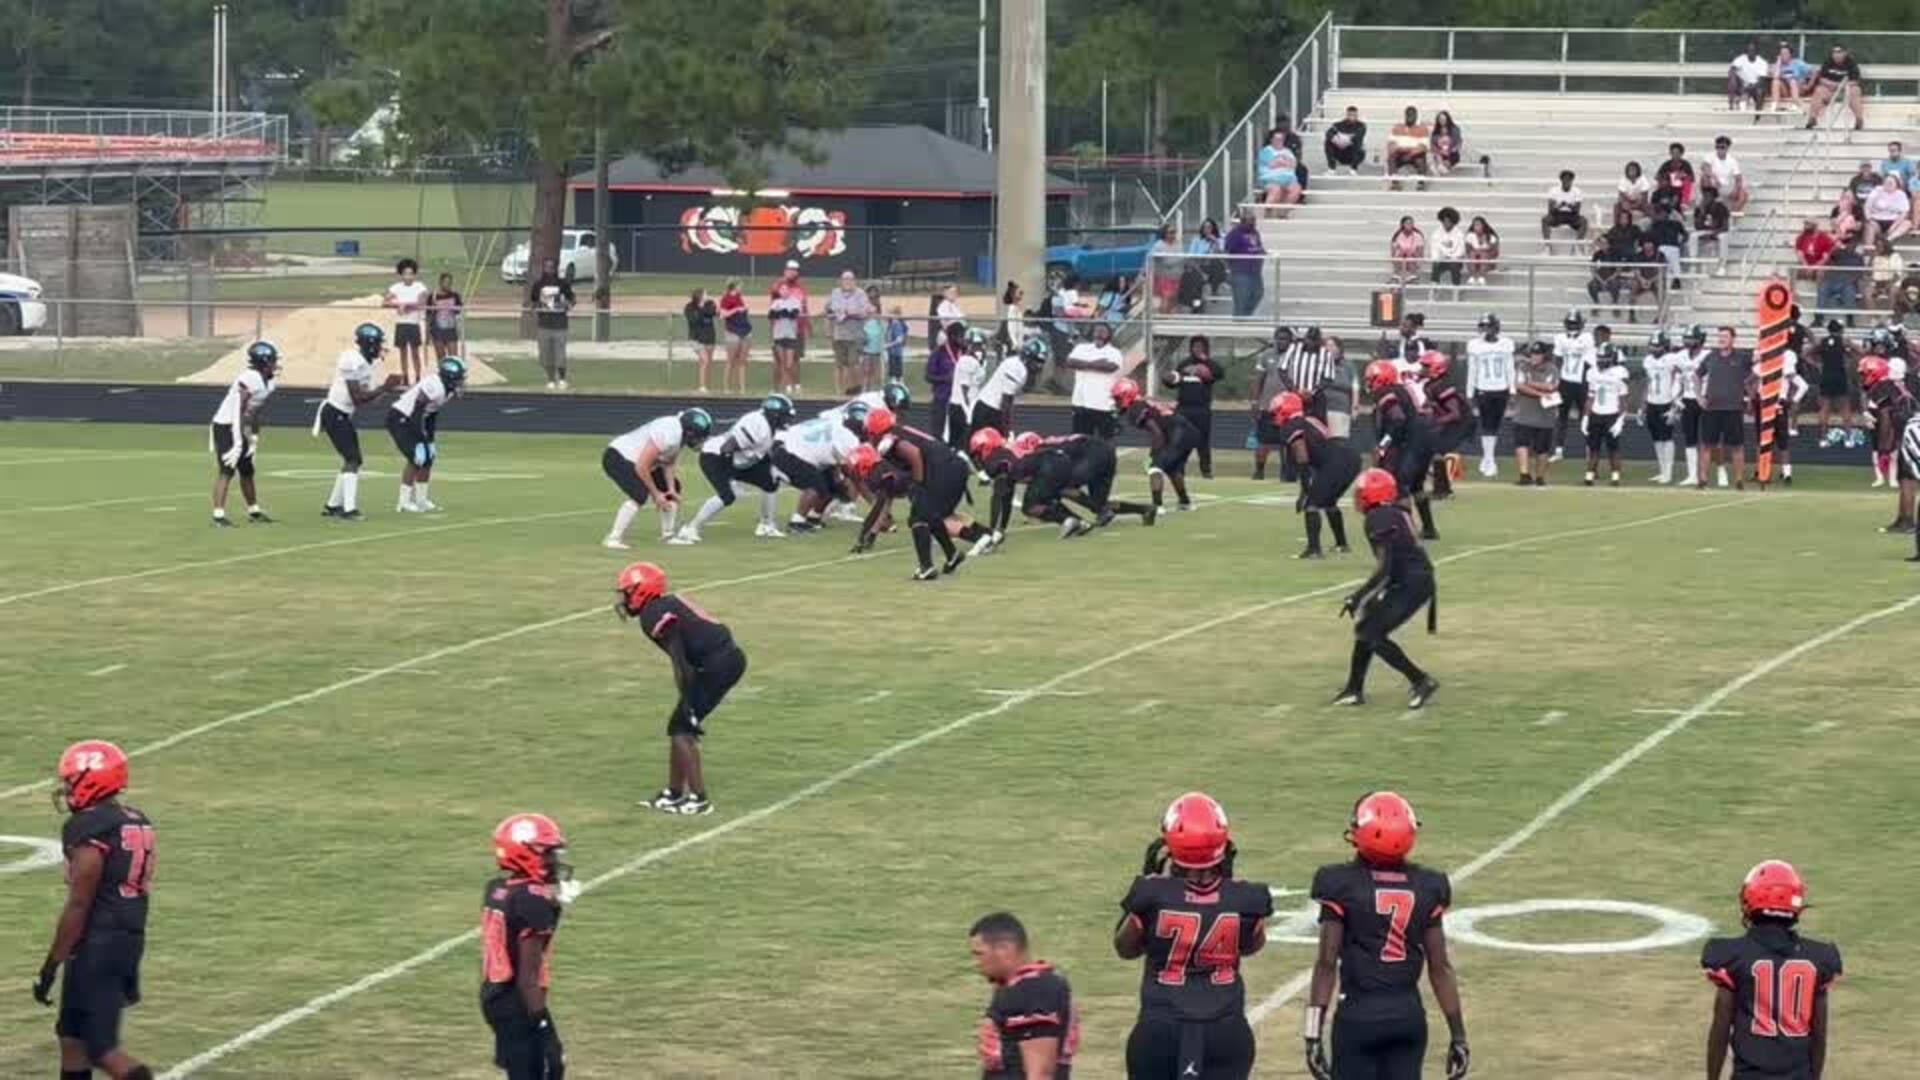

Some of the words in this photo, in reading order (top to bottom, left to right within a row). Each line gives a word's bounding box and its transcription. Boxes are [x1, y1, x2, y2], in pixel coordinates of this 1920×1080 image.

[1480, 356, 1505, 379] 10
[1156, 909, 1240, 985] 74
[1375, 888, 1415, 961] 7
[1751, 959, 1817, 1037] 10
